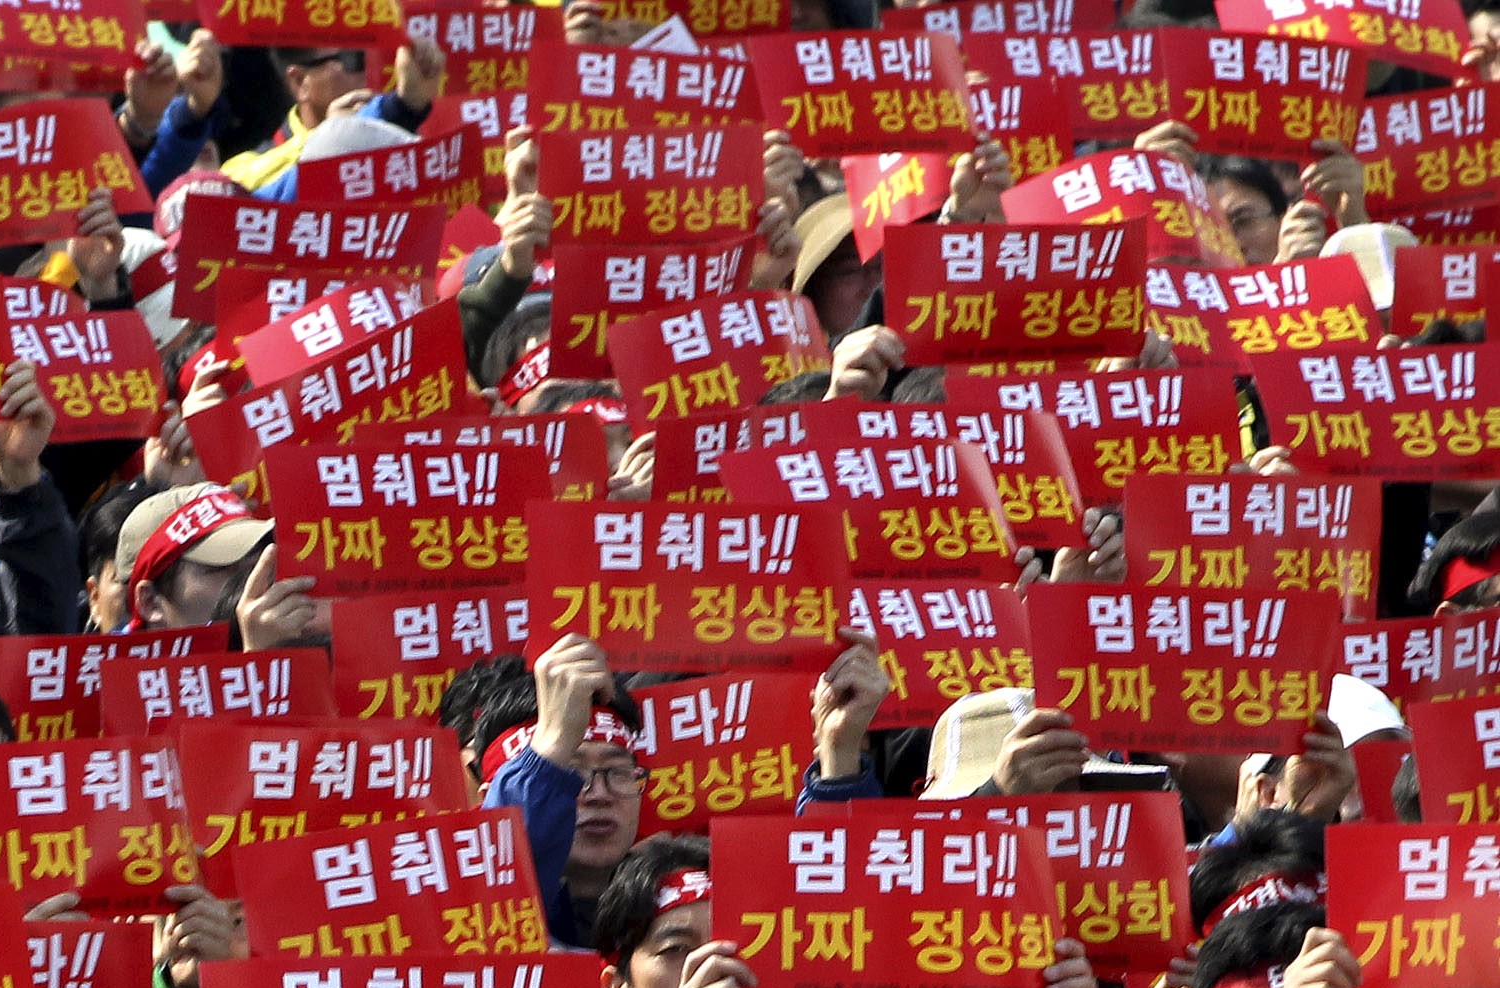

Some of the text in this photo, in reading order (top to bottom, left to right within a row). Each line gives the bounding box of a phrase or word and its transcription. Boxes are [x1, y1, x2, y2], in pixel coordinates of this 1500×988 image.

[783, 90, 968, 134] 가짜 정상화
[1186, 89, 1260, 132] 가짜
[554, 187, 751, 234] 가짜 정상화
[907, 285, 1145, 338] 가짜 정상화
[50, 370, 158, 416] 정상화
[643, 363, 739, 419] 가짜
[1287, 411, 1370, 455] 가짜
[1096, 435, 1228, 486] 정상화
[296, 518, 385, 568] 가짜
[1148, 546, 1369, 599] 가짜 정상화
[552, 583, 838, 643] 가짜 정상화
[1058, 664, 1317, 725] 가짜 정상화
[650, 744, 796, 818] 정상화
[740, 908, 872, 970] 가짜
[1358, 914, 1465, 976] 가짜
